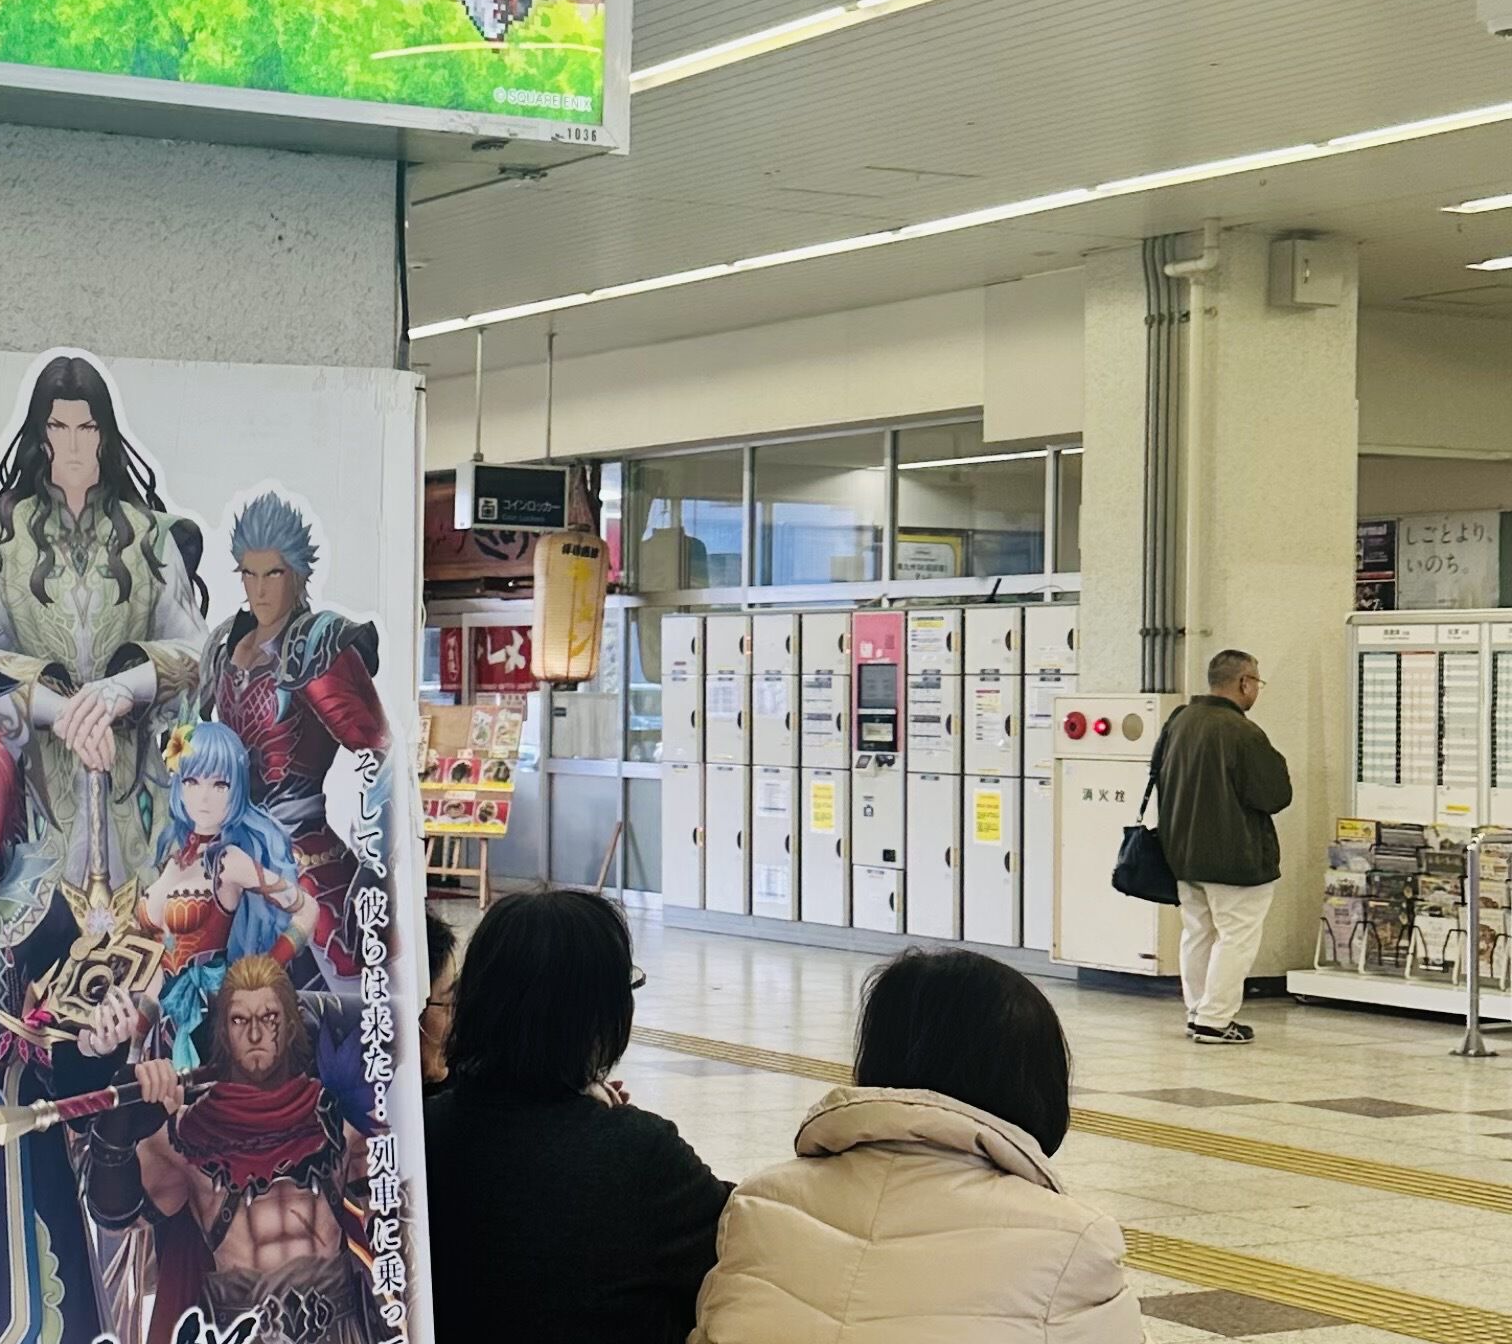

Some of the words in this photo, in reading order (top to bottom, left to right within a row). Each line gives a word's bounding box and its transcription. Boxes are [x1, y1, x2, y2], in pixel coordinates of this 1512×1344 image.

[507, 87, 561, 109] SQUARE
[563, 93, 593, 113] ENIX
[567, 127, 597, 143] 1036
[502, 499, 562, 513] コインロッカー
[1406, 522, 1493, 545] しごとより、
[1082, 788, 1127, 803] 消火栓
